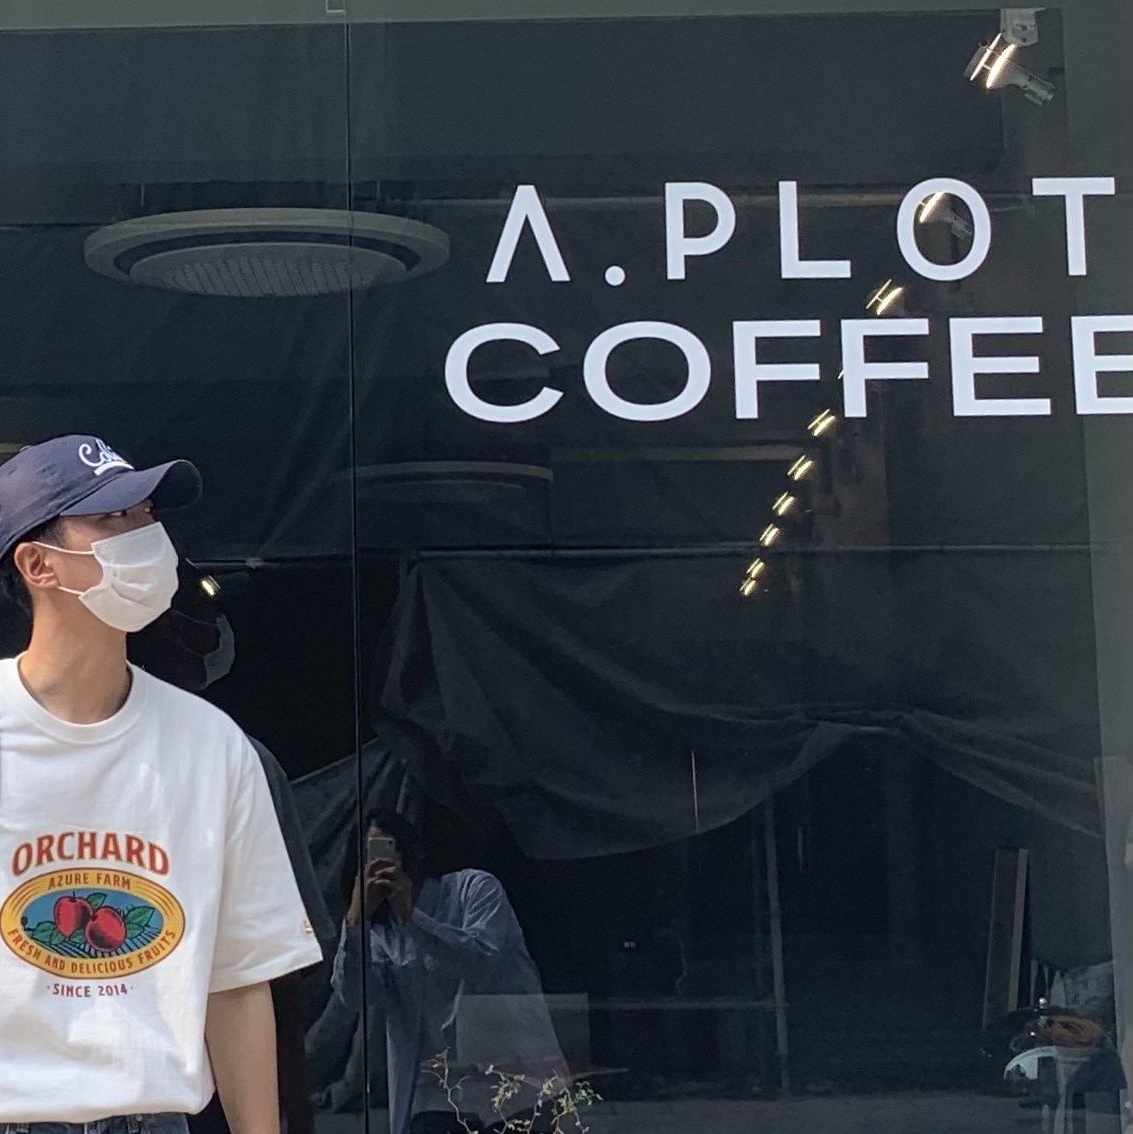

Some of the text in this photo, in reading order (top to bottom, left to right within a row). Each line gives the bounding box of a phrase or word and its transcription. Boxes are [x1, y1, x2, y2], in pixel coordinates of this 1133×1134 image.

[444, 315, 1133, 423] COFFEE
[12, 831, 170, 877] ORCHARD
[48, 873, 131, 890] AZURE FARM
[7, 929, 176, 974] FRESH AND DELICIOUS FRUITS
[53, 983, 128, 998] SINCE 2014
